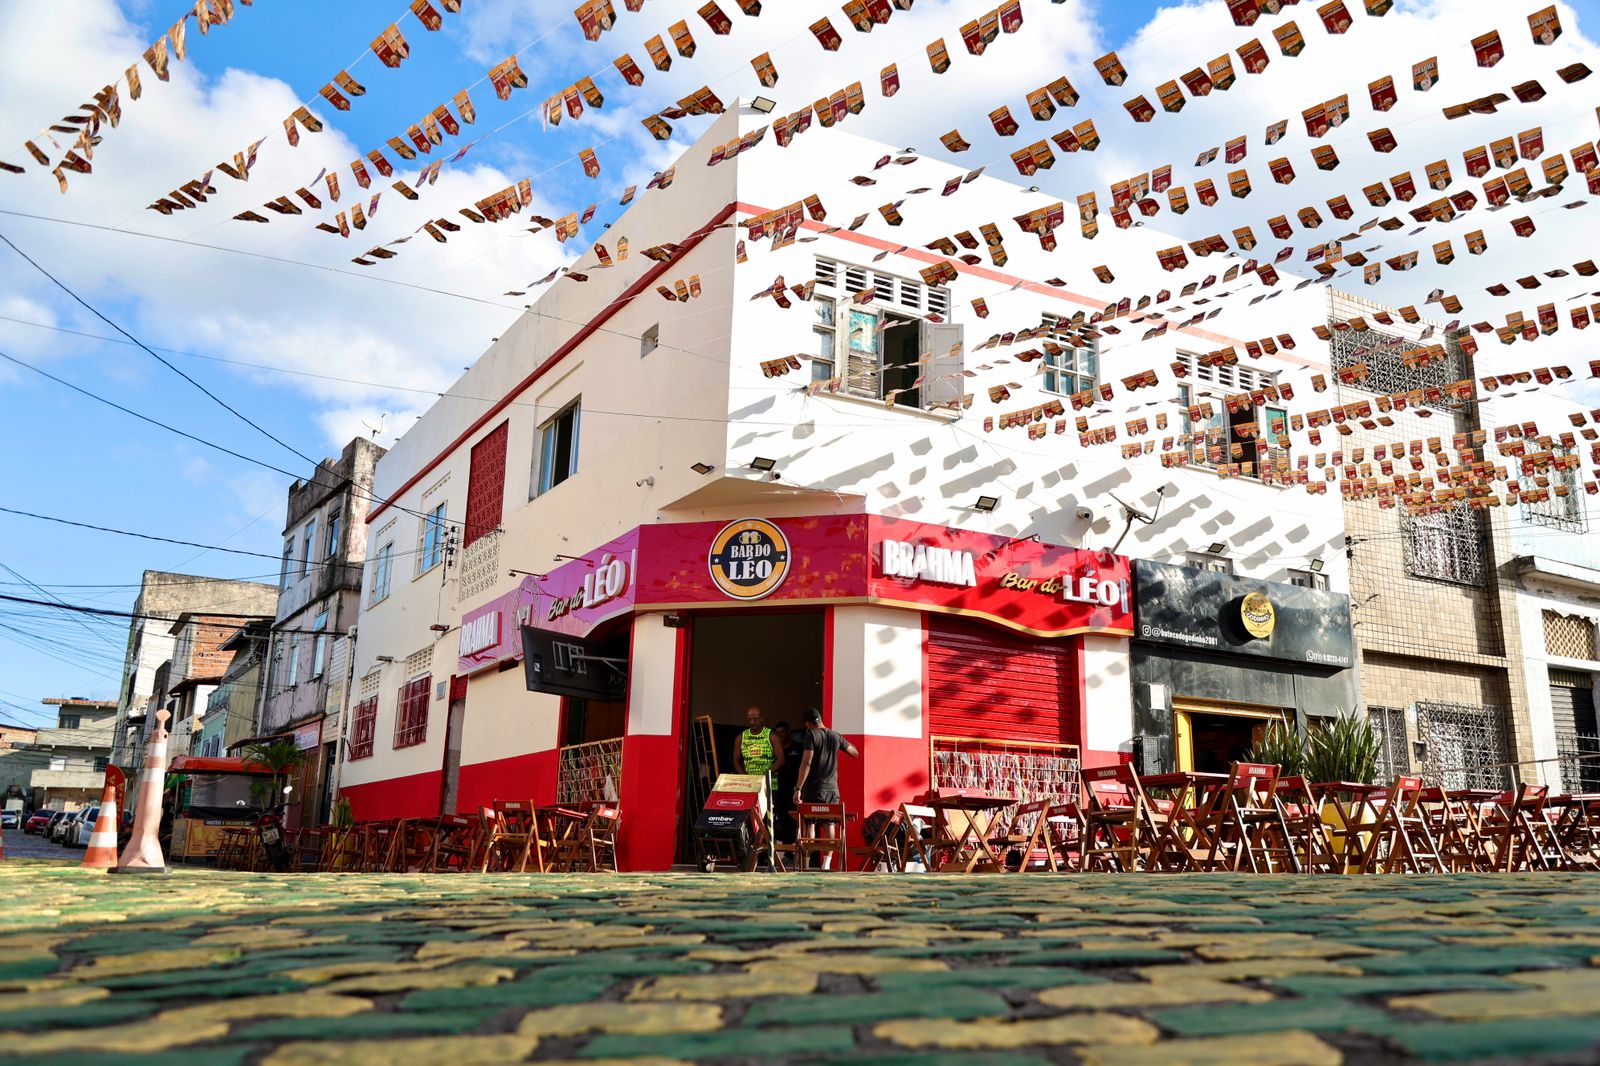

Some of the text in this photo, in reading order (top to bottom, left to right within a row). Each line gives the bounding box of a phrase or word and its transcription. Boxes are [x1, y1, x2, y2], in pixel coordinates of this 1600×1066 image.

[731, 543, 771, 558] BAR DO
[882, 539, 977, 587] BRAHMA
[728, 557, 773, 580] LÉO
[548, 553, 625, 621] Bar do LÉO
[1000, 569, 1120, 606] Bar do LÉO
[459, 611, 499, 658] BRAHMA
[1097, 768, 1117, 778] BRAHMA
[811, 805, 830, 813] BRAHMA
